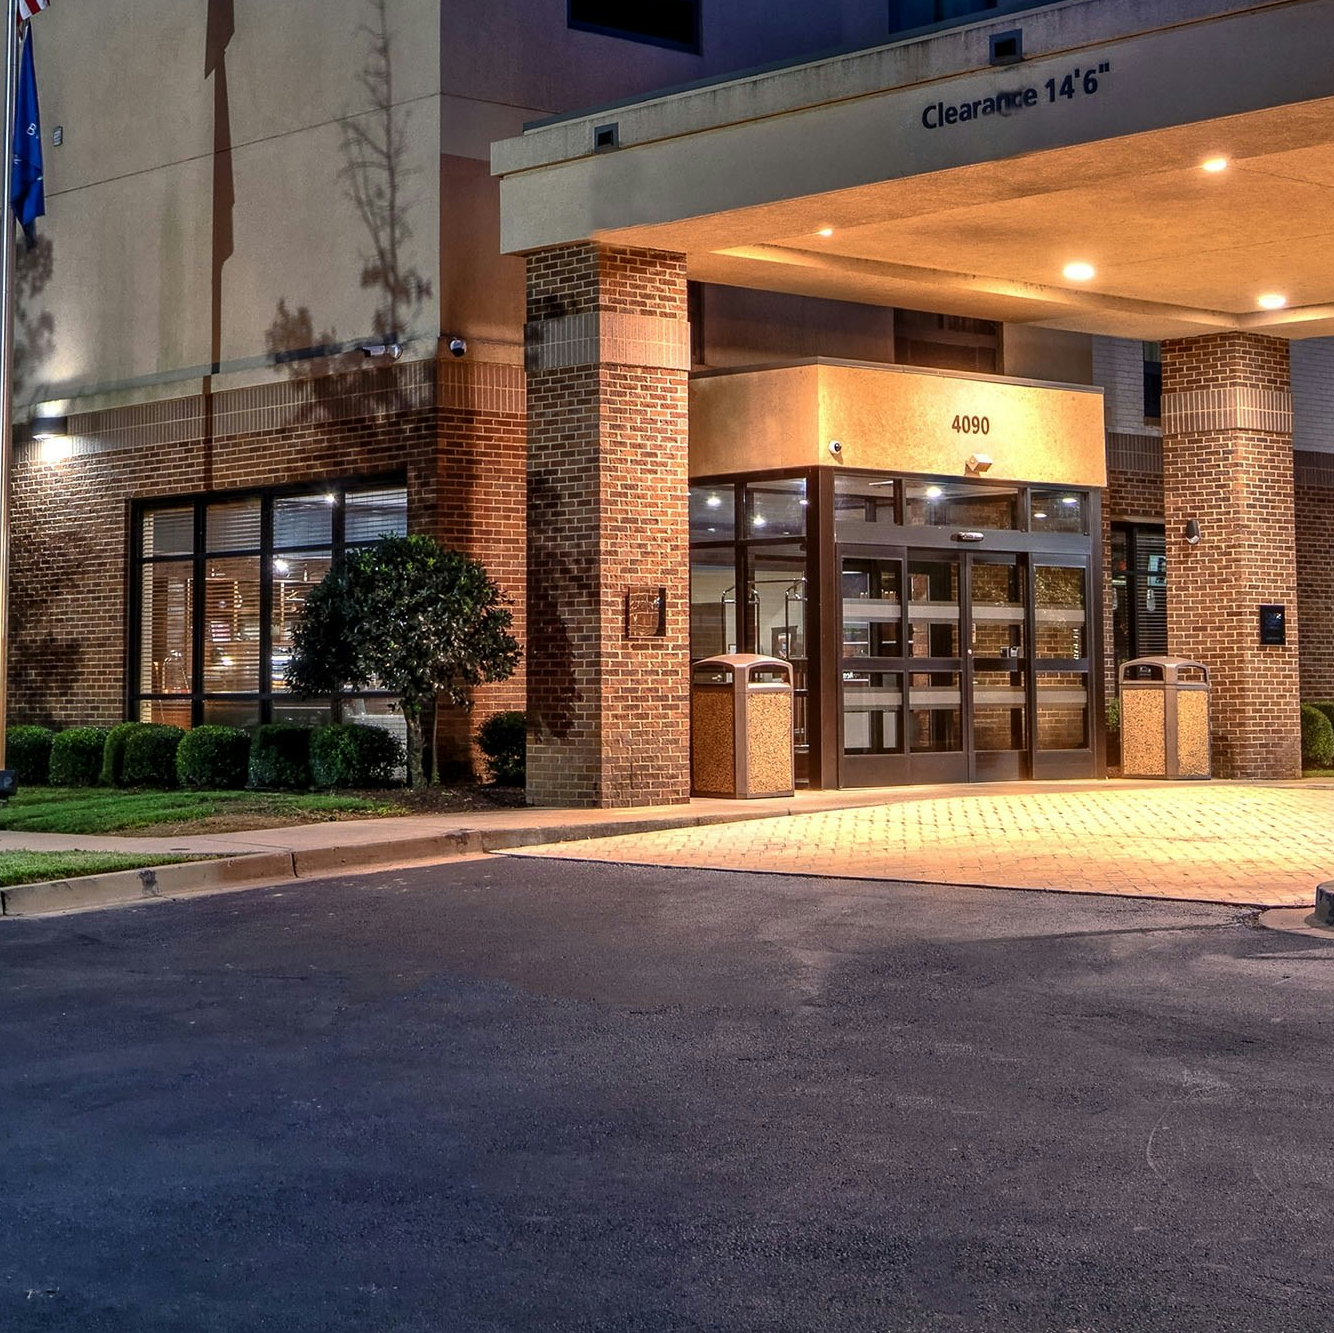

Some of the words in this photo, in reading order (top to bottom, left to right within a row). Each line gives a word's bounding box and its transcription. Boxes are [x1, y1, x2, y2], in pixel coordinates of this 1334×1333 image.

[922, 87, 1038, 130] Clearance
[1044, 63, 1110, 103] 14'6"
[951, 414, 990, 435] 4090
